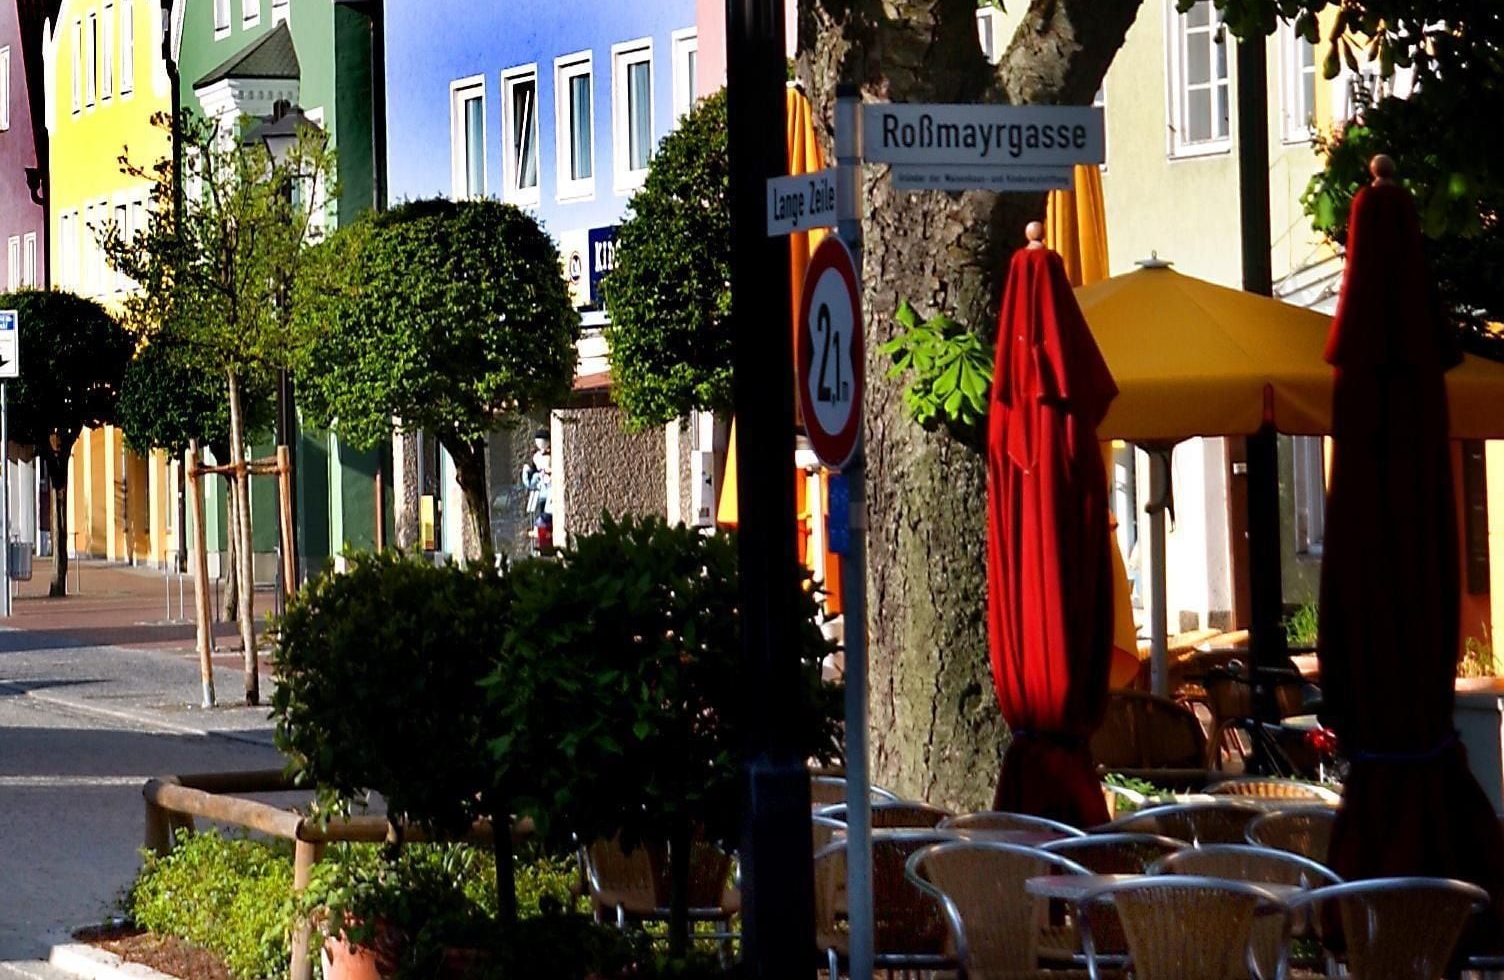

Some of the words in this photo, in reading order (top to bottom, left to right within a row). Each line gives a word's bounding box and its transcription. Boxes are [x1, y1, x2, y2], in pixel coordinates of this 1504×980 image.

[882, 113, 1087, 158] Roßmayrgasse
[774, 187, 805, 227] Lange
[809, 177, 835, 215] Zeile
